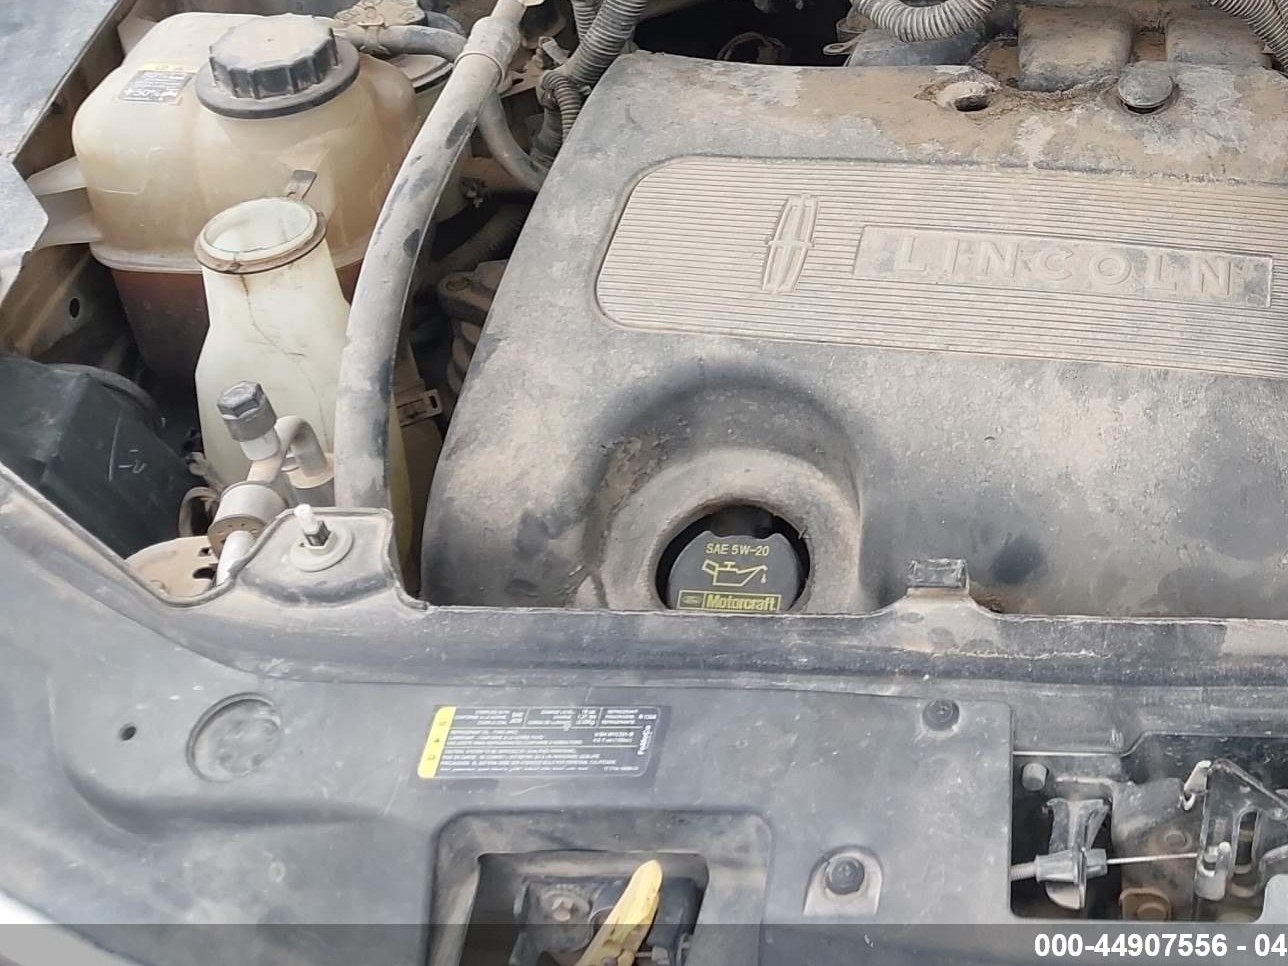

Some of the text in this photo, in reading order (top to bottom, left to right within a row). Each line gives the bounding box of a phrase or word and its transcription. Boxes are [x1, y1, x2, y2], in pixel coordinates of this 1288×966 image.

[892, 236, 1235, 297] LINCOLN
[705, 543, 770, 557] SAE 5W-20
[706, 594, 775, 611] Motorcraft
